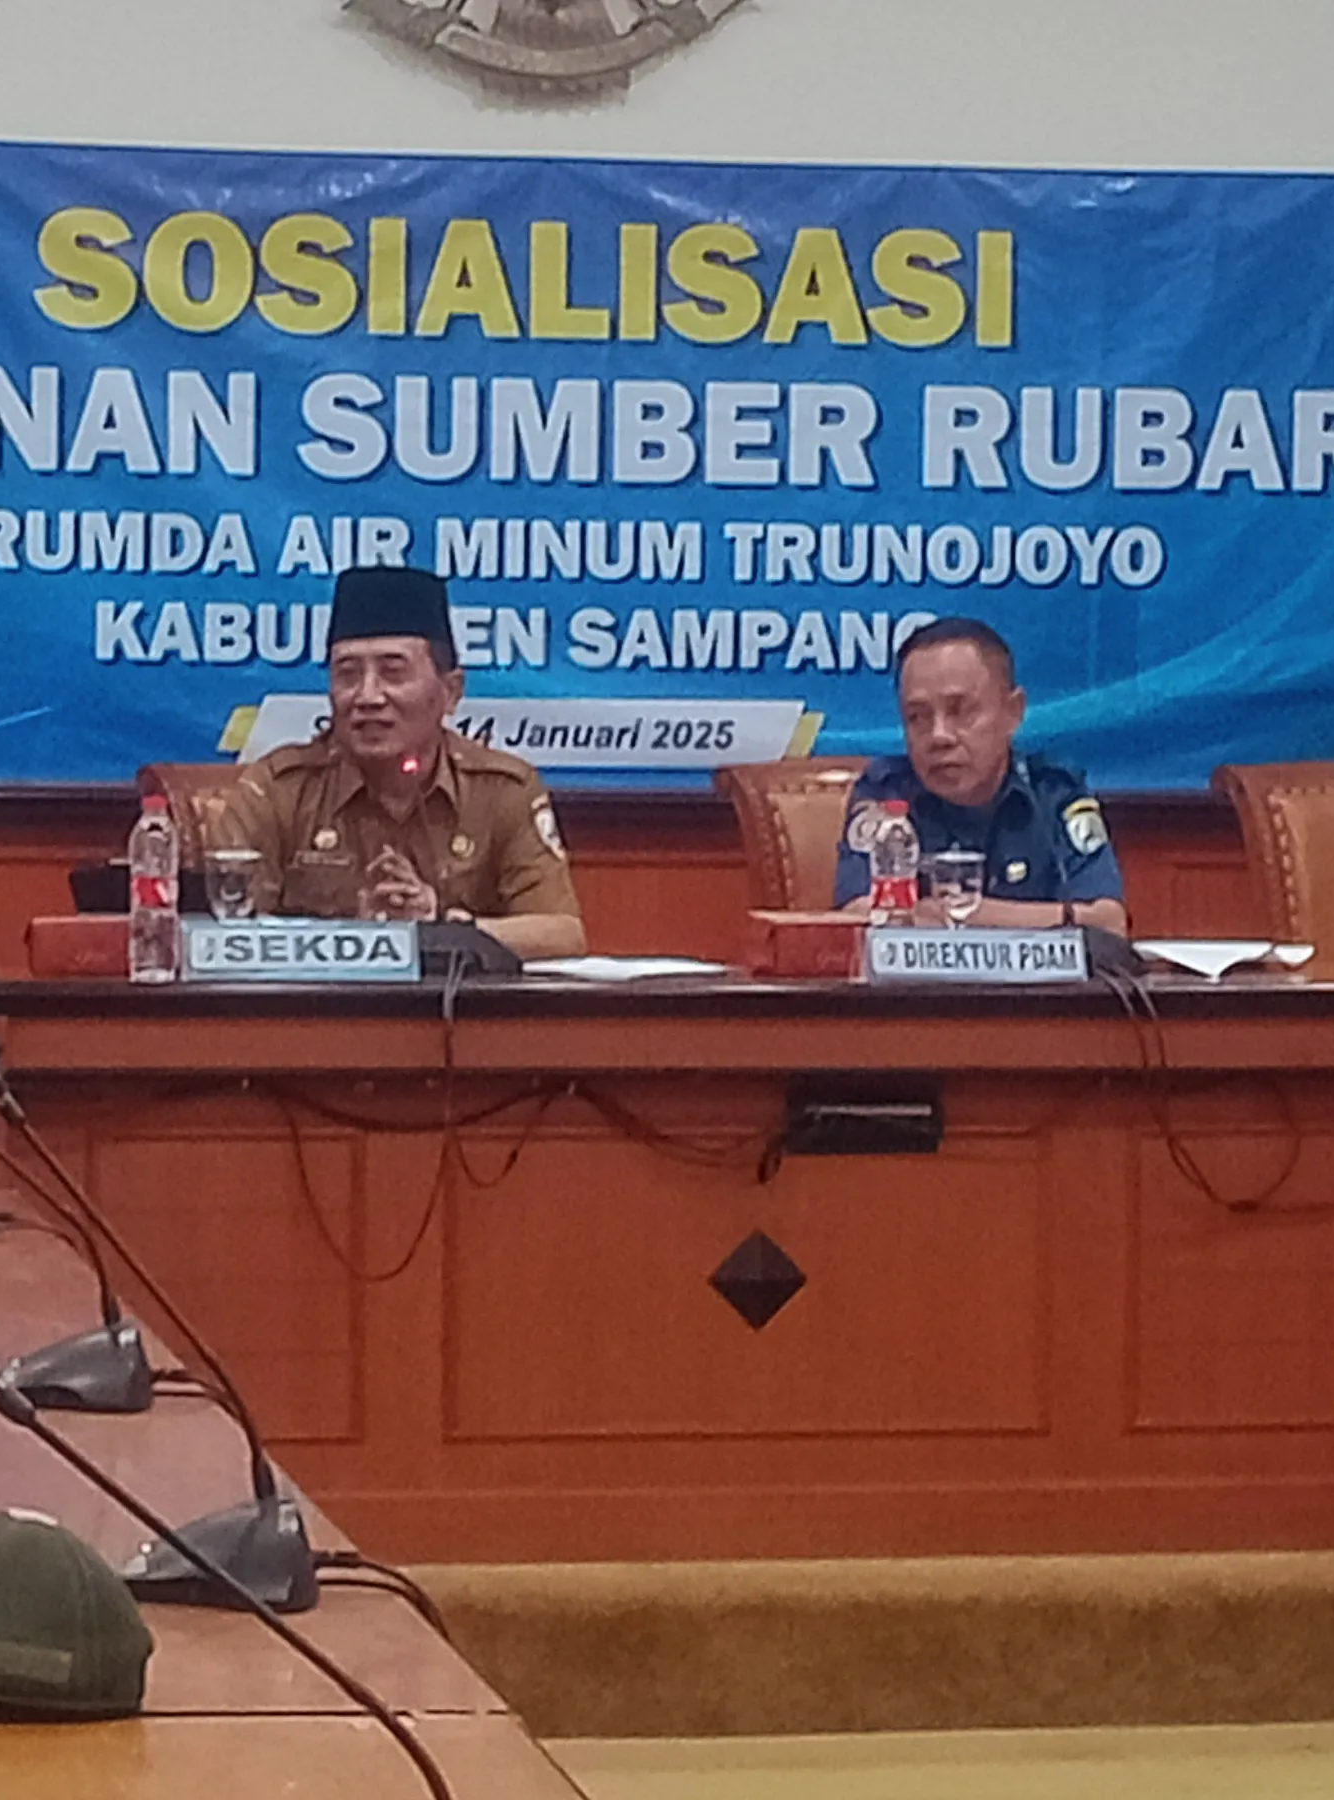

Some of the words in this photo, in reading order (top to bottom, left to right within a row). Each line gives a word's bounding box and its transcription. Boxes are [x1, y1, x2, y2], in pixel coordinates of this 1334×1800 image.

[33, 206, 1014, 348] SOSIALISASI
[296, 373, 877, 492] SUMBER
[276, 515, 408, 575] AIR
[435, 517, 703, 583] MINUM
[723, 522, 1164, 587] TRUNOJOYO
[94, 599, 547, 668] KABUEN
[504, 713, 644, 749] Januari
[650, 719, 736, 751] 2025
[224, 934, 401, 963] SEKDA
[903, 942, 1012, 969] DIREKTUR
[1019, 943, 1077, 970] PDAM
